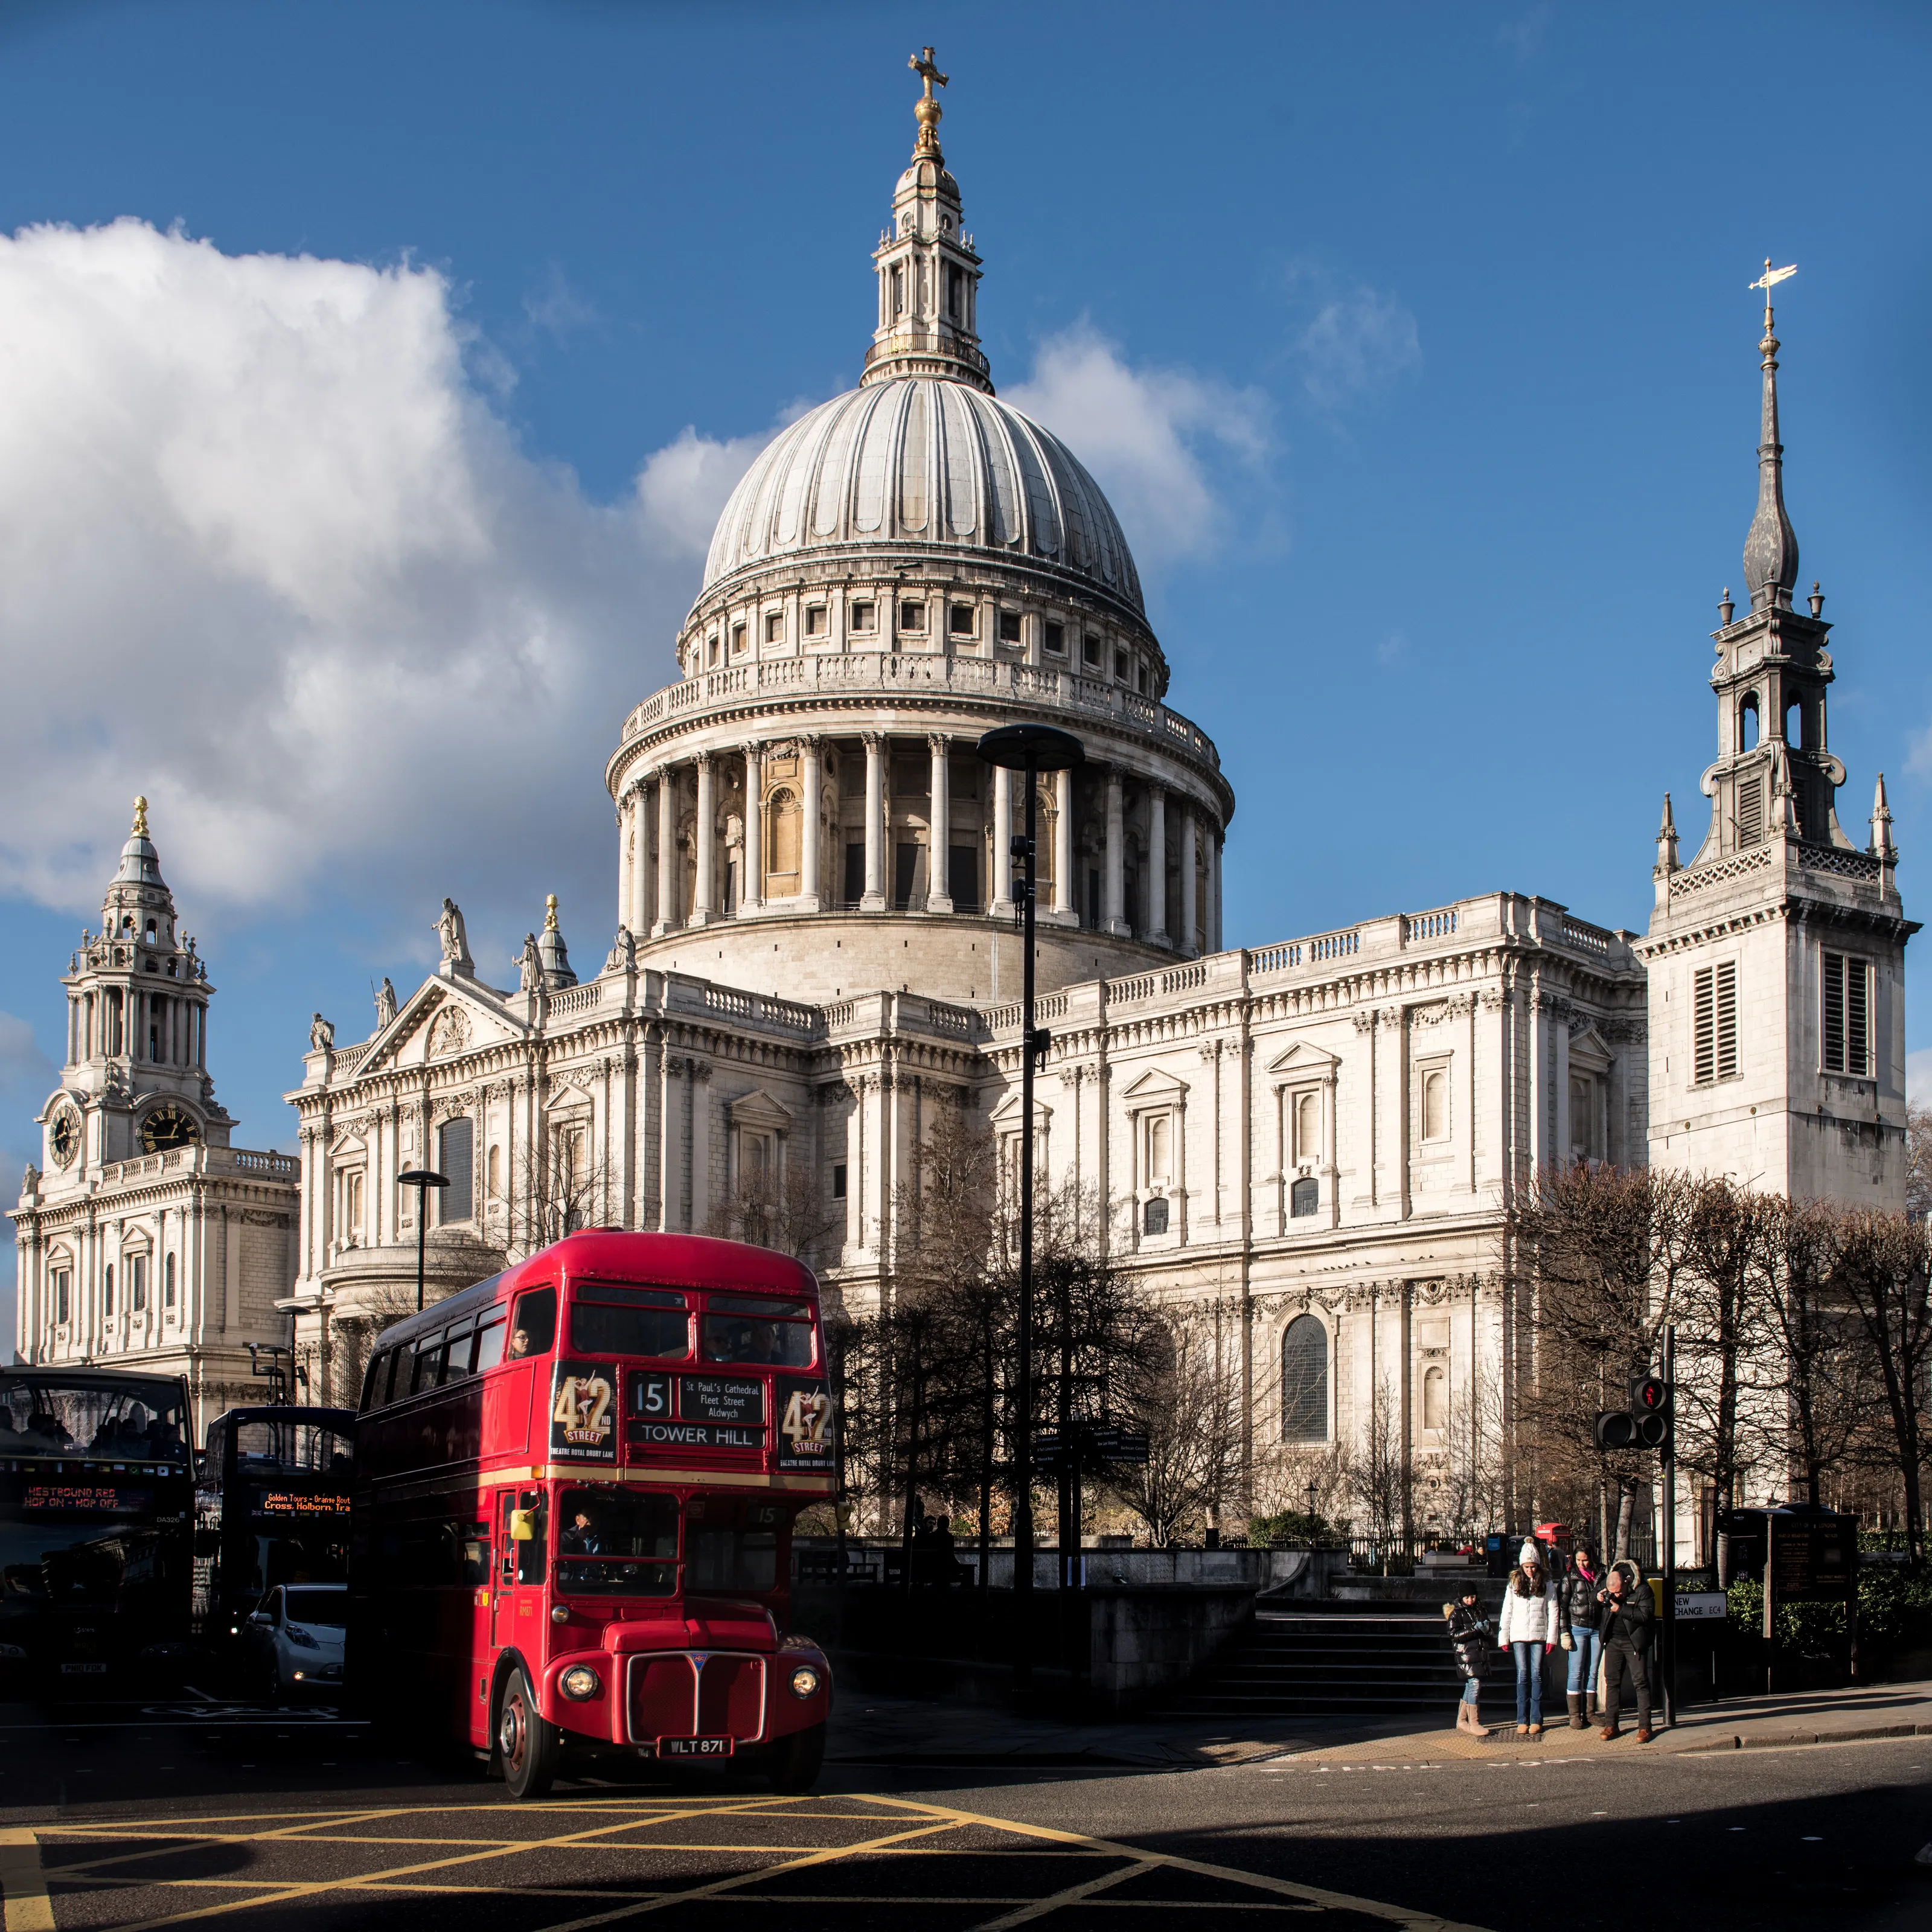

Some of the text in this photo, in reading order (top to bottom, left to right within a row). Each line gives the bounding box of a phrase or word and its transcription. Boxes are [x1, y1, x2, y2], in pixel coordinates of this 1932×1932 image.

[686, 1381, 759, 1395] St Paul's Cathedral
[638, 1382, 664, 1412] 15
[701, 1395, 745, 1406] Fleet Street
[708, 1407, 738, 1420] Aldwych
[567, 1430, 601, 1443] STREET
[642, 1425, 753, 1445] TOWER HILL
[794, 1442, 825, 1453] STREET
[28, 1487, 116, 1498] WESTBOUND RED
[268, 1493, 287, 1502] Golden
[289, 1494, 307, 1502] Tours
[314, 1494, 335, 1504] Orange
[24, 1497, 45, 1507] HOP
[49, 1497, 65, 1507] ON
[75, 1499, 97, 1508] HOP
[100, 1499, 119, 1508] OFF
[264, 1500, 351, 1512] Cross, Holborn, Tra
[758, 1508, 776, 1523] 15
[1675, 1606, 1721, 1616] CHANGE EC4
[671, 1739, 723, 1753] WLT 871
